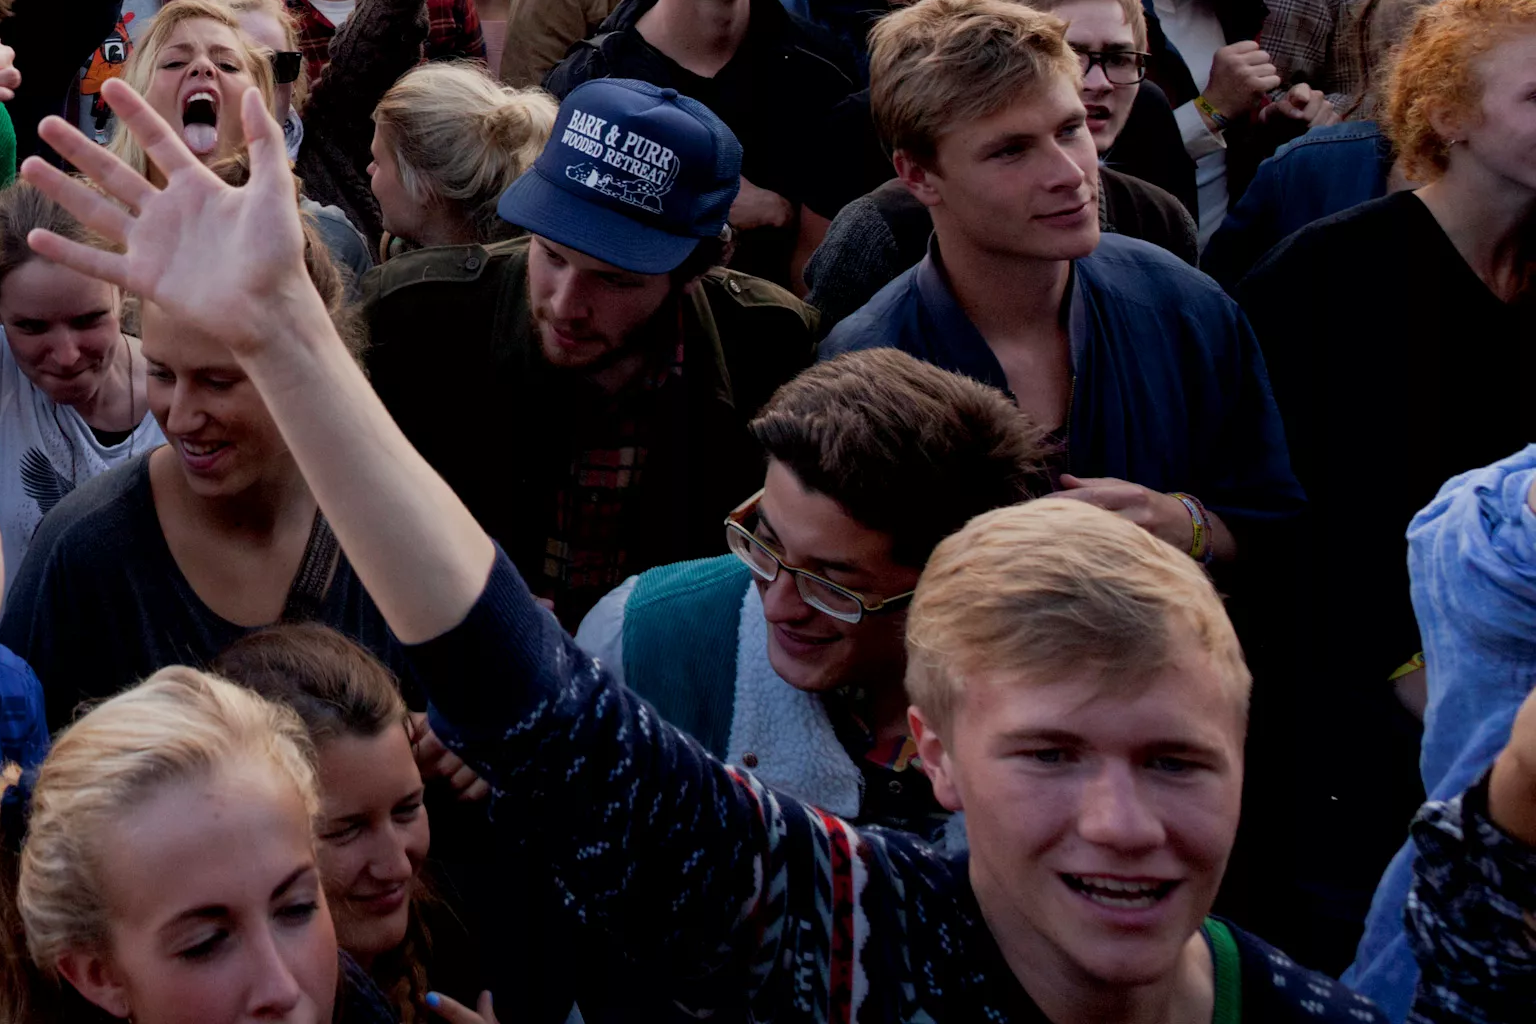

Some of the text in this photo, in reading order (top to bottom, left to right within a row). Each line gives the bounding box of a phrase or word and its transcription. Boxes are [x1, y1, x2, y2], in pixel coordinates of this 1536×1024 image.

[561, 129, 667, 186] WOODED RETREAT
[567, 109, 674, 171] BARK & PURR
